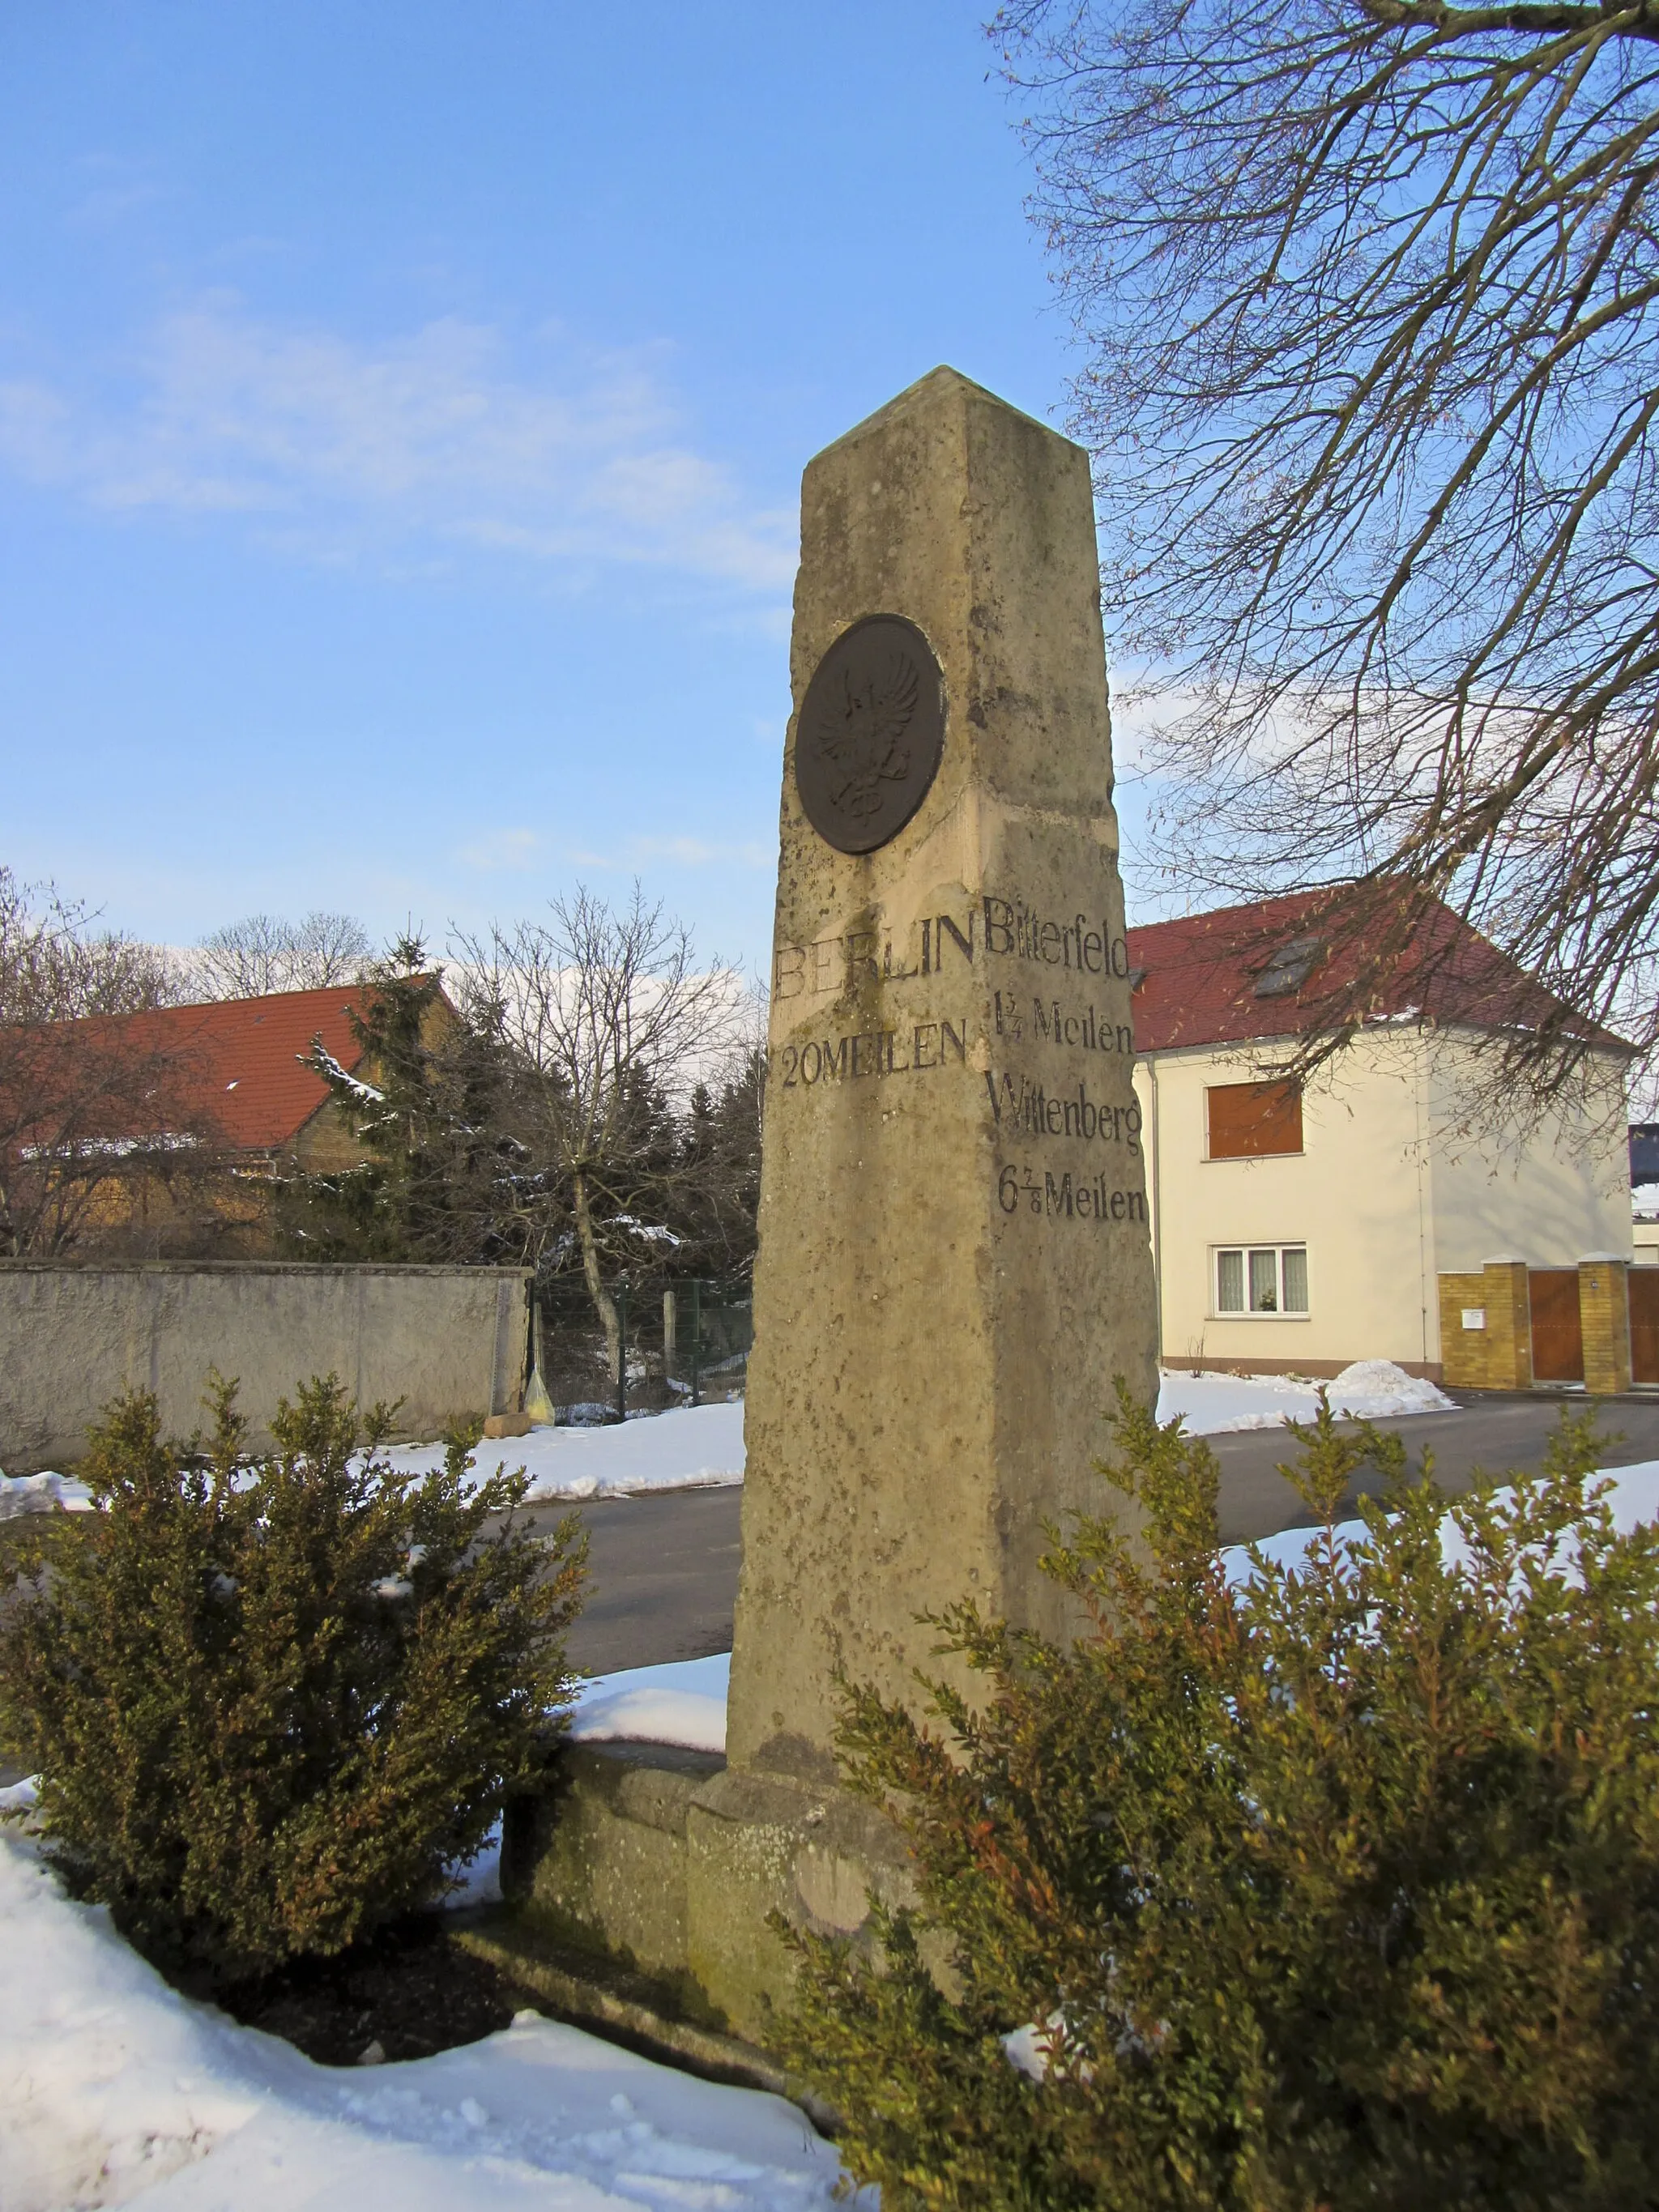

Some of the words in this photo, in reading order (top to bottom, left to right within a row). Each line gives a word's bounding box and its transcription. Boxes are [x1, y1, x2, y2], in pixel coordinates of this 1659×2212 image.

[774, 910, 974, 1002] BERLIN
[983, 1069, 1142, 1157] Wittenberg
[1044, 1171, 1146, 1220] Meilen
